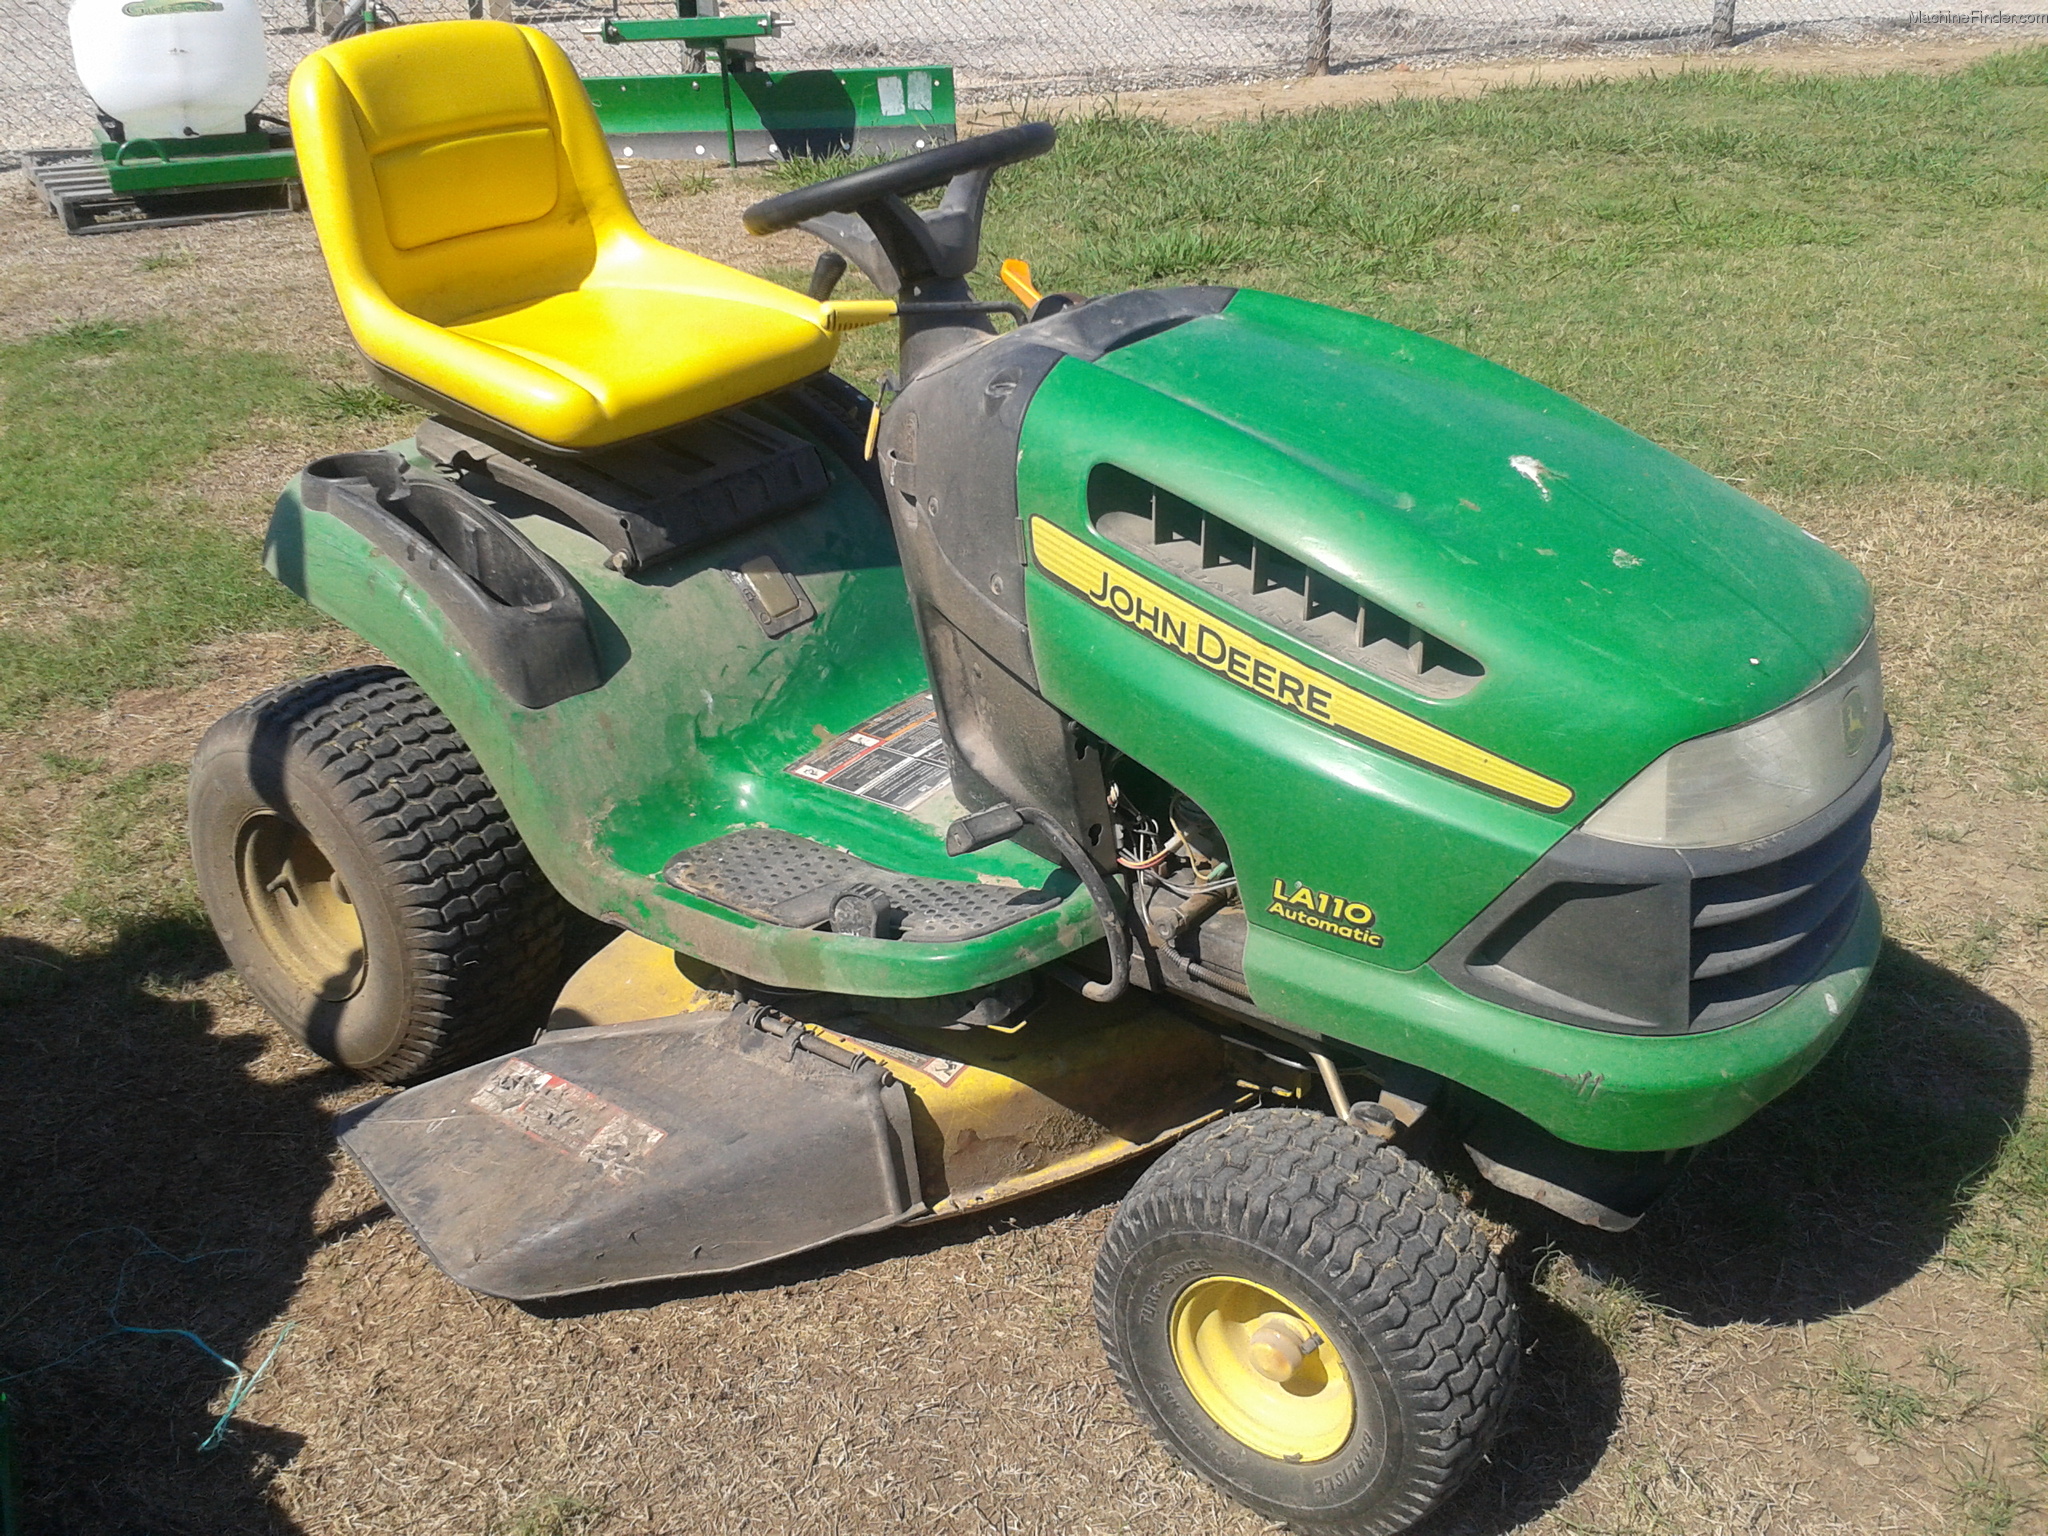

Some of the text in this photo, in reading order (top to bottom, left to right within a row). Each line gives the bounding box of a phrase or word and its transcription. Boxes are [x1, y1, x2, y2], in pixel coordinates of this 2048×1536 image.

[1089, 571, 1333, 721] JOHN DEERE
[1267, 902, 1383, 947] Automatic
[1272, 878, 1374, 926] LA110
[1313, 1428, 1375, 1496] CARLISLE
